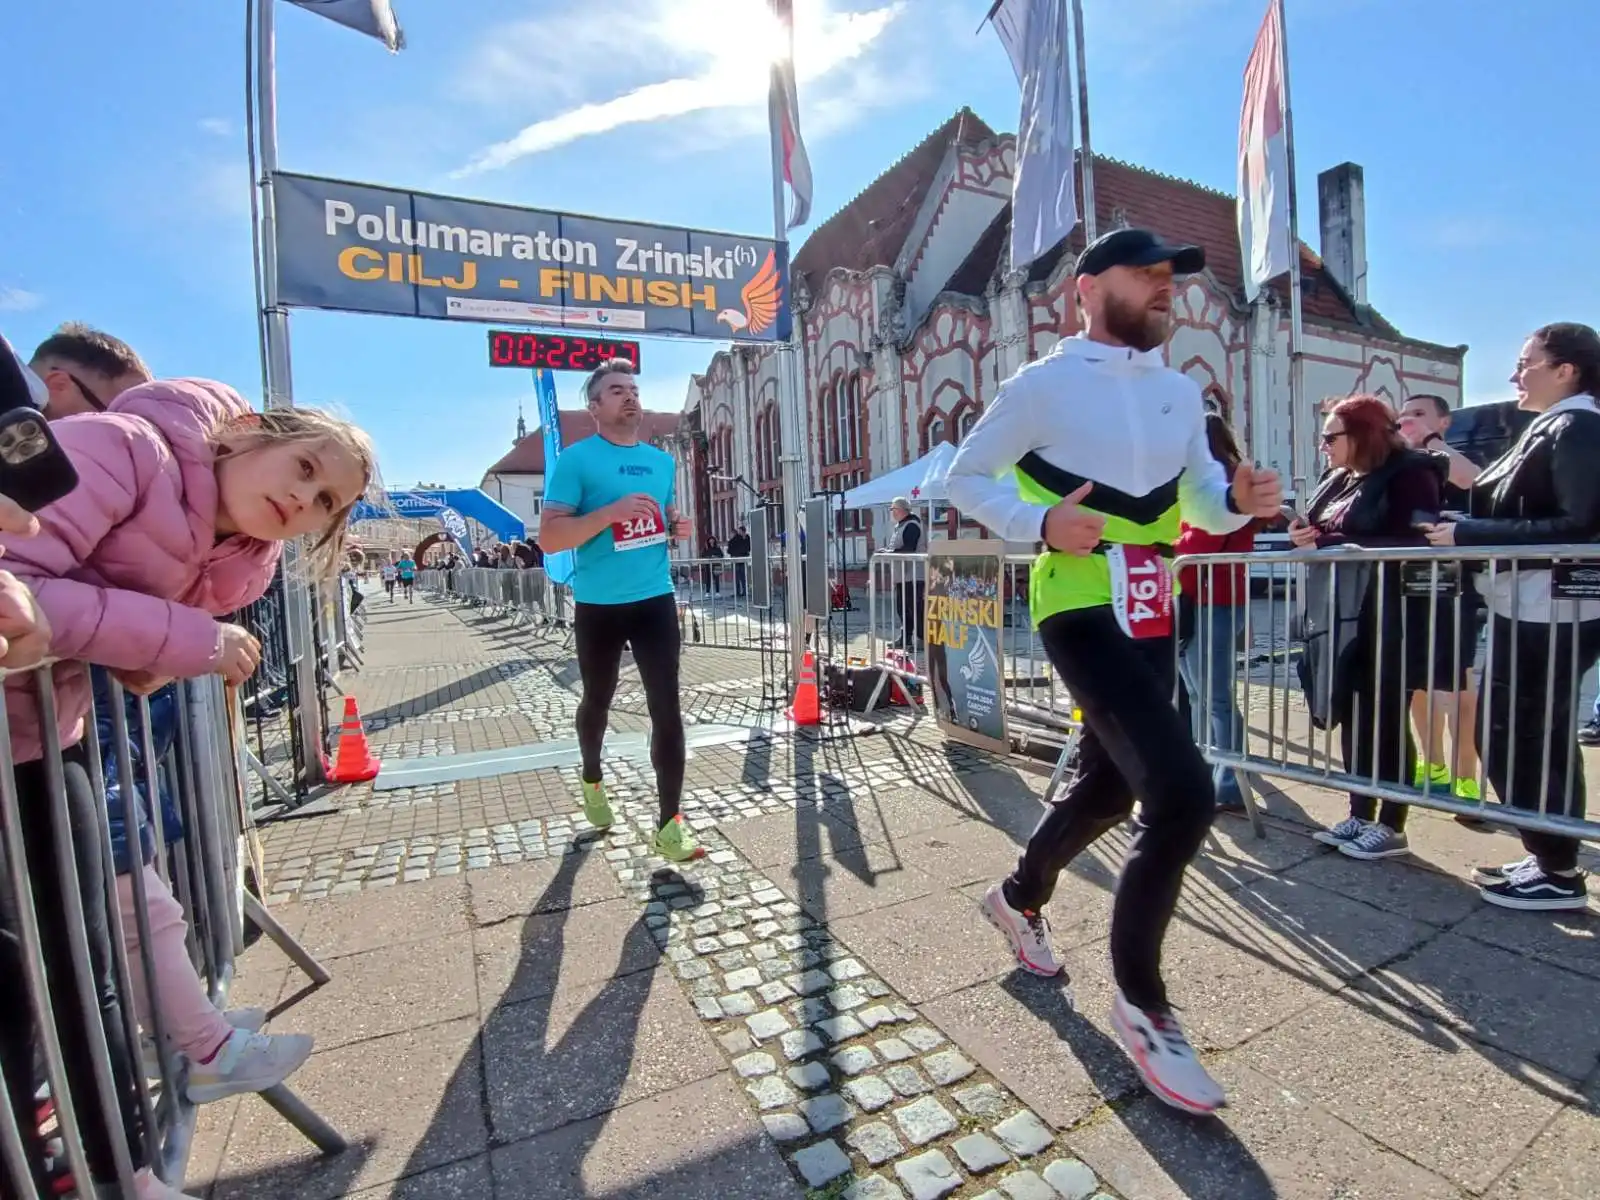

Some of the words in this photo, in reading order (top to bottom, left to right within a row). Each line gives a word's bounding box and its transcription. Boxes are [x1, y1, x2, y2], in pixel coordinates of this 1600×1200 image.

[324, 199, 598, 267] Polumaraton
[337, 246, 478, 290] CILJ
[540, 268, 717, 312] FINISH
[493, 333, 637, 370] 00:22:47
[621, 516, 658, 540] 344
[1129, 559, 1159, 624] 194
[927, 594, 998, 629] ZRINSKI
[927, 619, 969, 650] HALF
